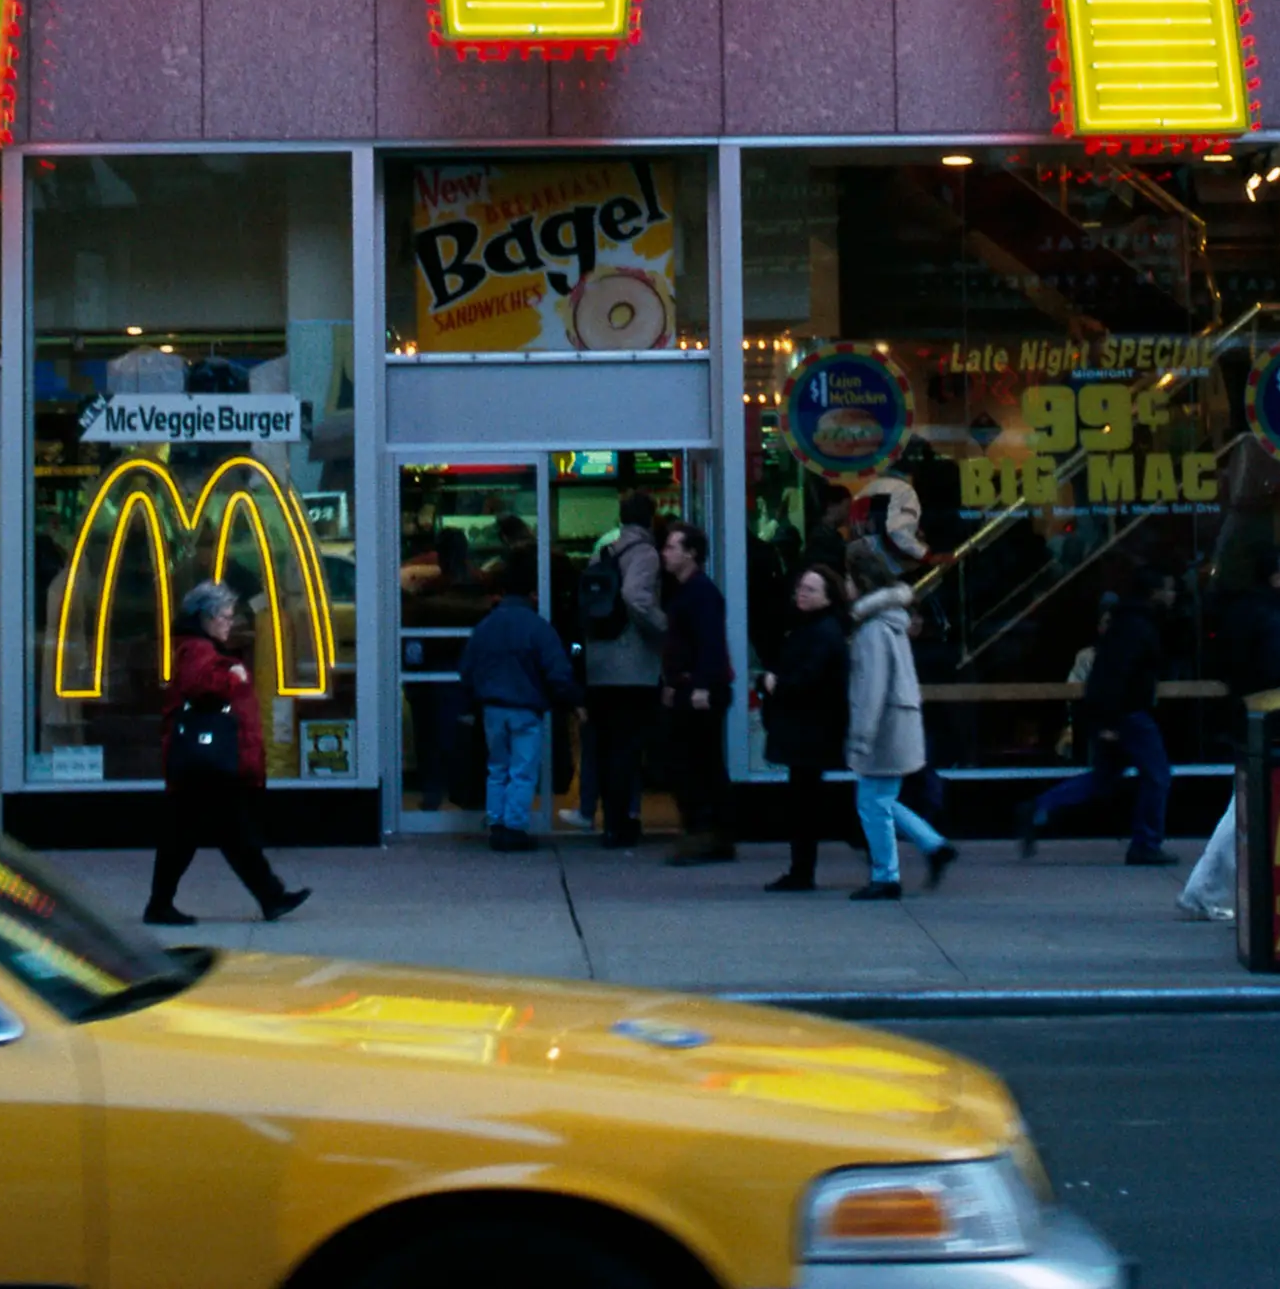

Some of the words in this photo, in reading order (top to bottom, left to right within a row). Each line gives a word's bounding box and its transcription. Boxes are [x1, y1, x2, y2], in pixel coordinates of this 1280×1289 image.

[414, 159, 669, 310] Bagel
[949, 341, 1010, 373] Late
[1019, 338, 1091, 377] Night
[1099, 334, 1216, 369] SPECIAL
[105, 404, 211, 438] McVeggie
[217, 405, 295, 439] Burger
[960, 453, 1059, 508] BIG
[1086, 451, 1220, 504] MAC
